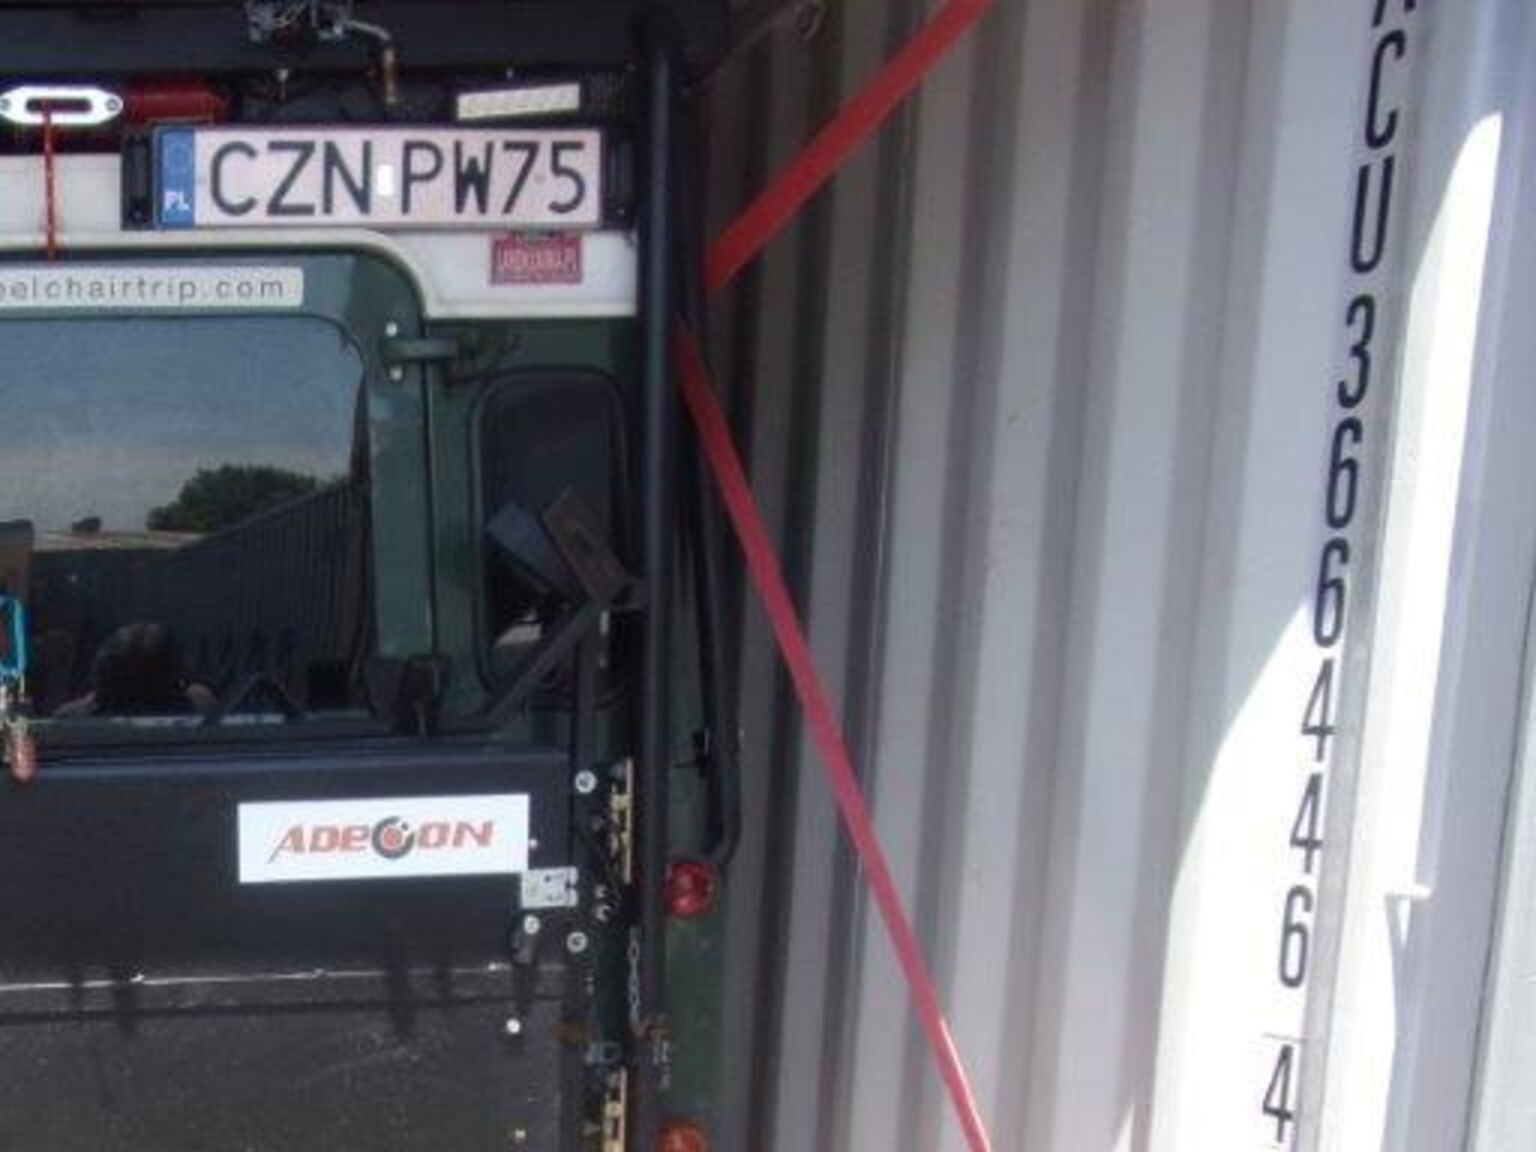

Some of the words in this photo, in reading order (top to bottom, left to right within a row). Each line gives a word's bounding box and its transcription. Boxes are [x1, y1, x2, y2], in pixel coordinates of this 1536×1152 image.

[165, 191, 191, 212] PL
[210, 140, 372, 217] CZN
[401, 139, 586, 215] PW75
